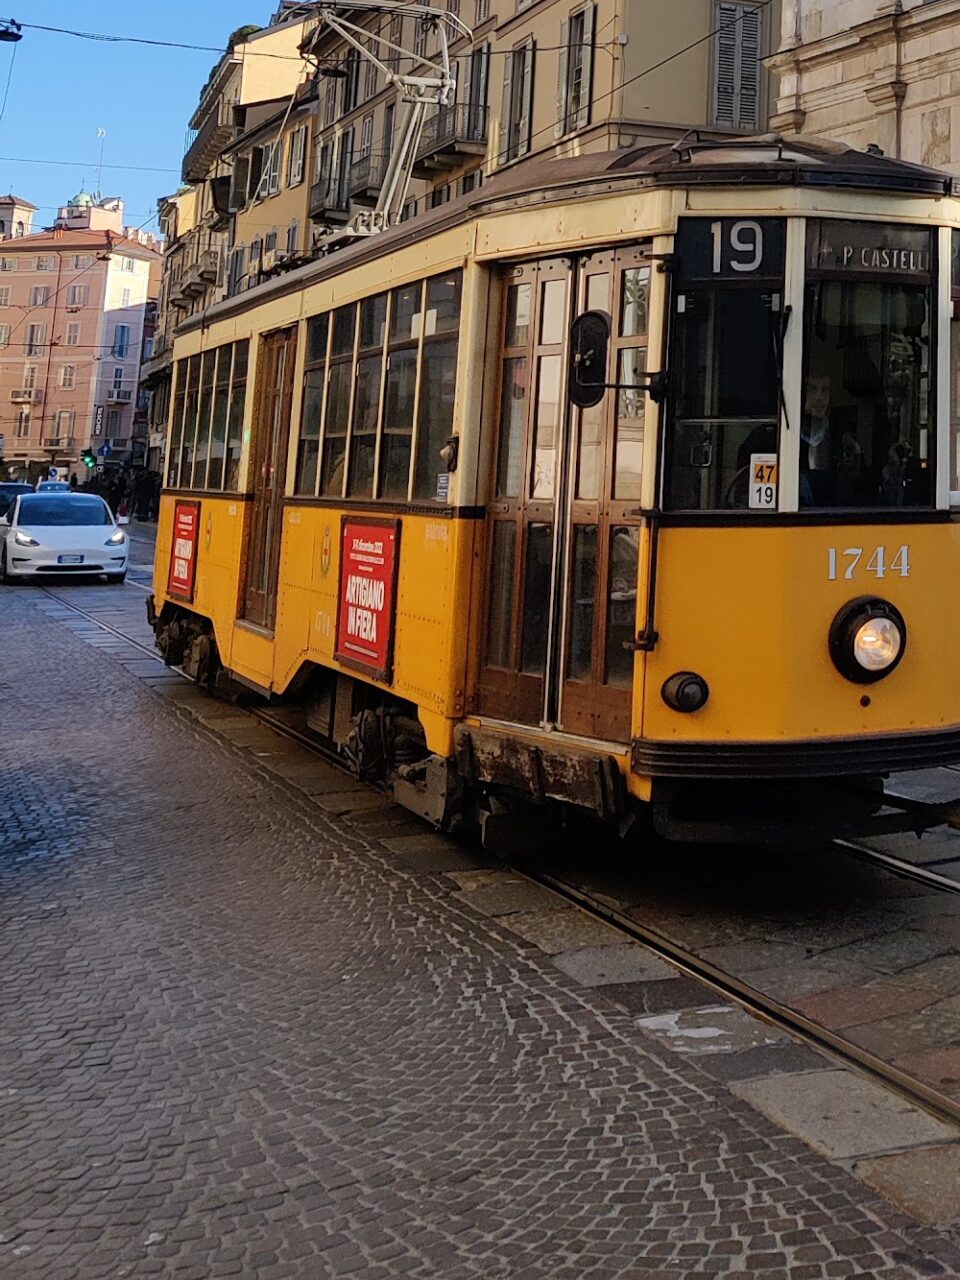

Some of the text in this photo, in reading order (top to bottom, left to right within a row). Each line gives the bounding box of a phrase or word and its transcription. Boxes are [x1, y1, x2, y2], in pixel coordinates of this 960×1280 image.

[711, 220, 763, 273] 19
[755, 465, 775, 483] 47
[755, 486, 774, 504] 19
[827, 545, 911, 580] 1744
[345, 574, 385, 612] ARTIGIANO
[355, 608, 377, 643] FIERA
